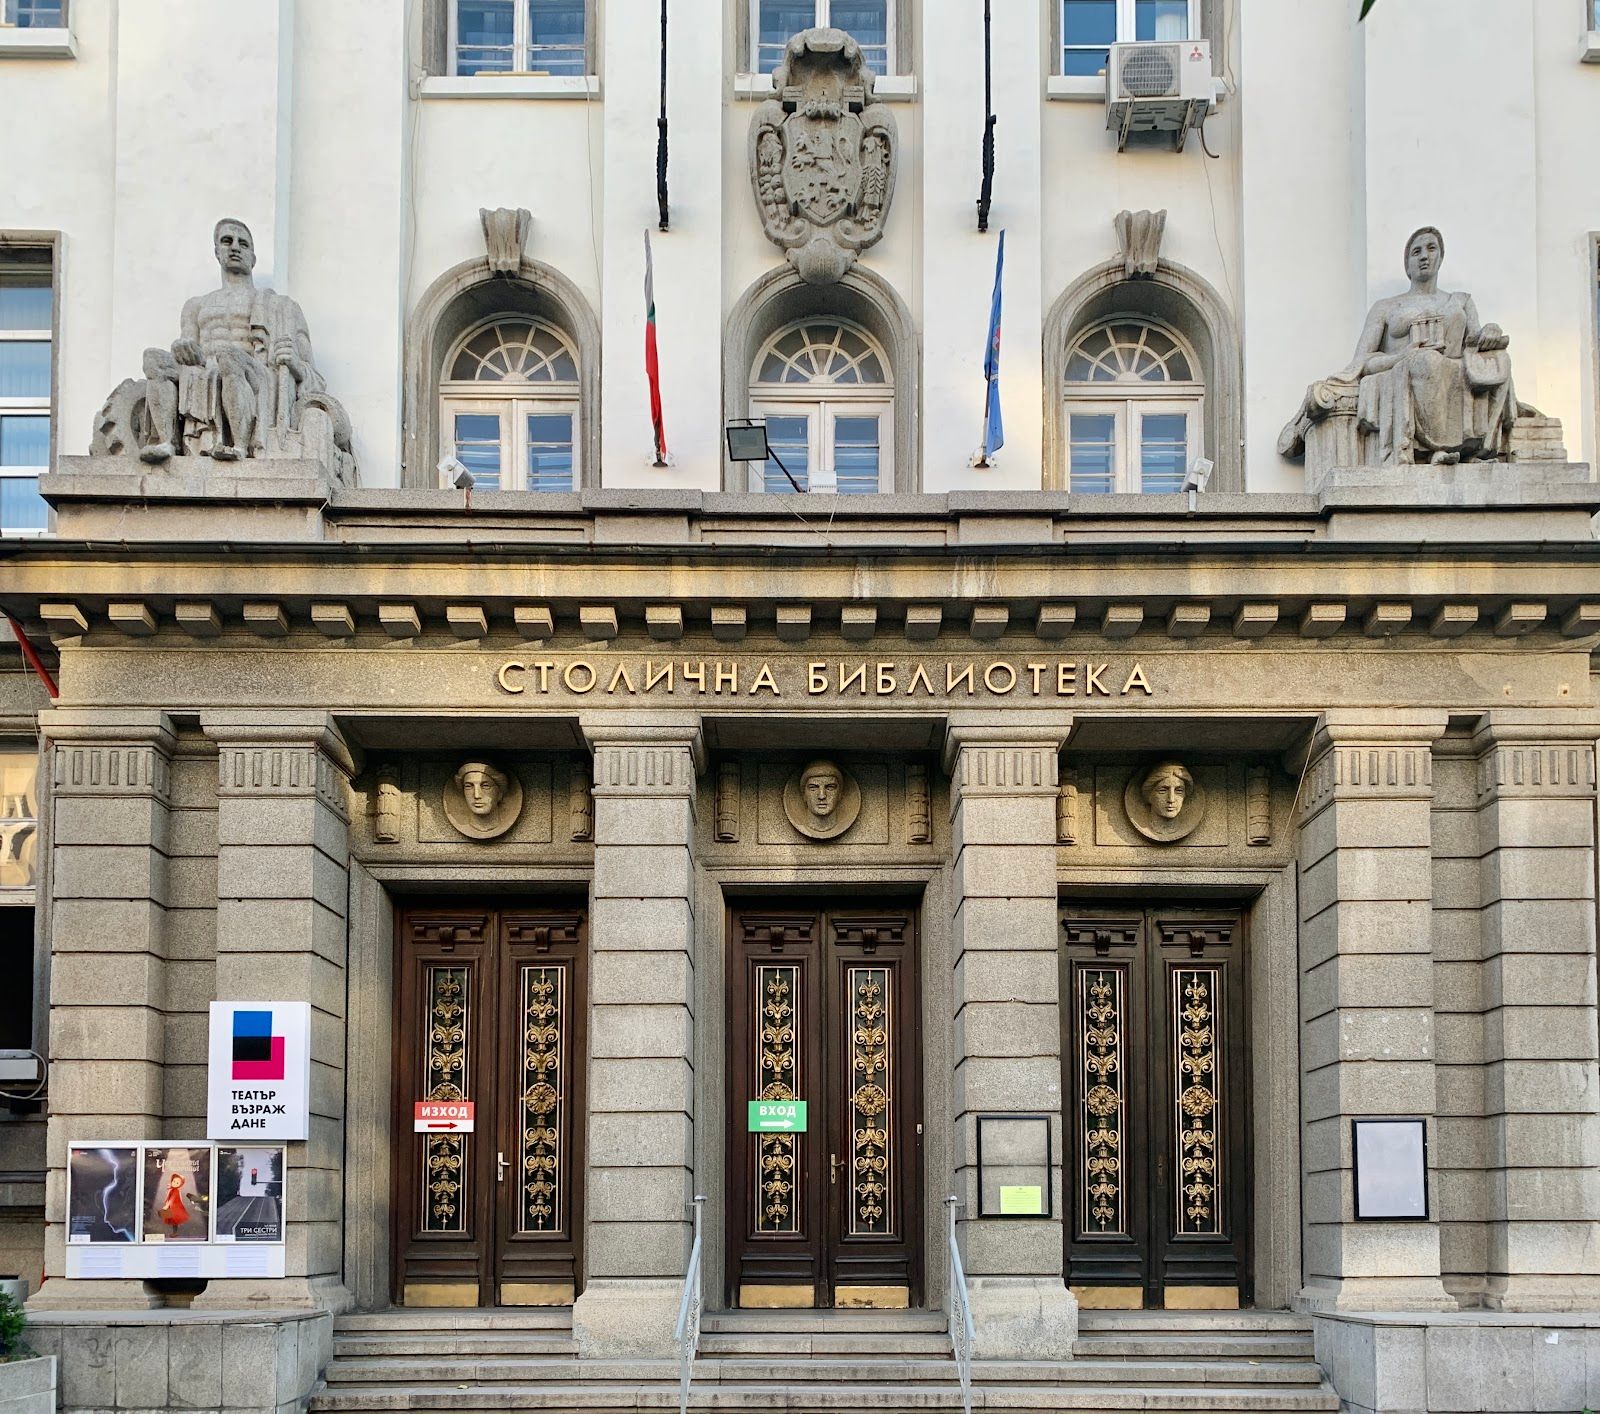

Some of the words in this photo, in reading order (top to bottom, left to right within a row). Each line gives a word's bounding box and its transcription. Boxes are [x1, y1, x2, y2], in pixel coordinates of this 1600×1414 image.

[498, 661, 780, 695] СТОЛИЧНА
[808, 661, 1153, 695] БИБЛИОТЕКА
[231, 1090, 276, 1100] ТЕАТЪР
[231, 1104, 286, 1114] ВЪЗРАЖ
[421, 1106, 468, 1119] ИЗХОД
[759, 1105, 796, 1118] ВХОД
[230, 1118, 266, 1130] ДАНЕ
